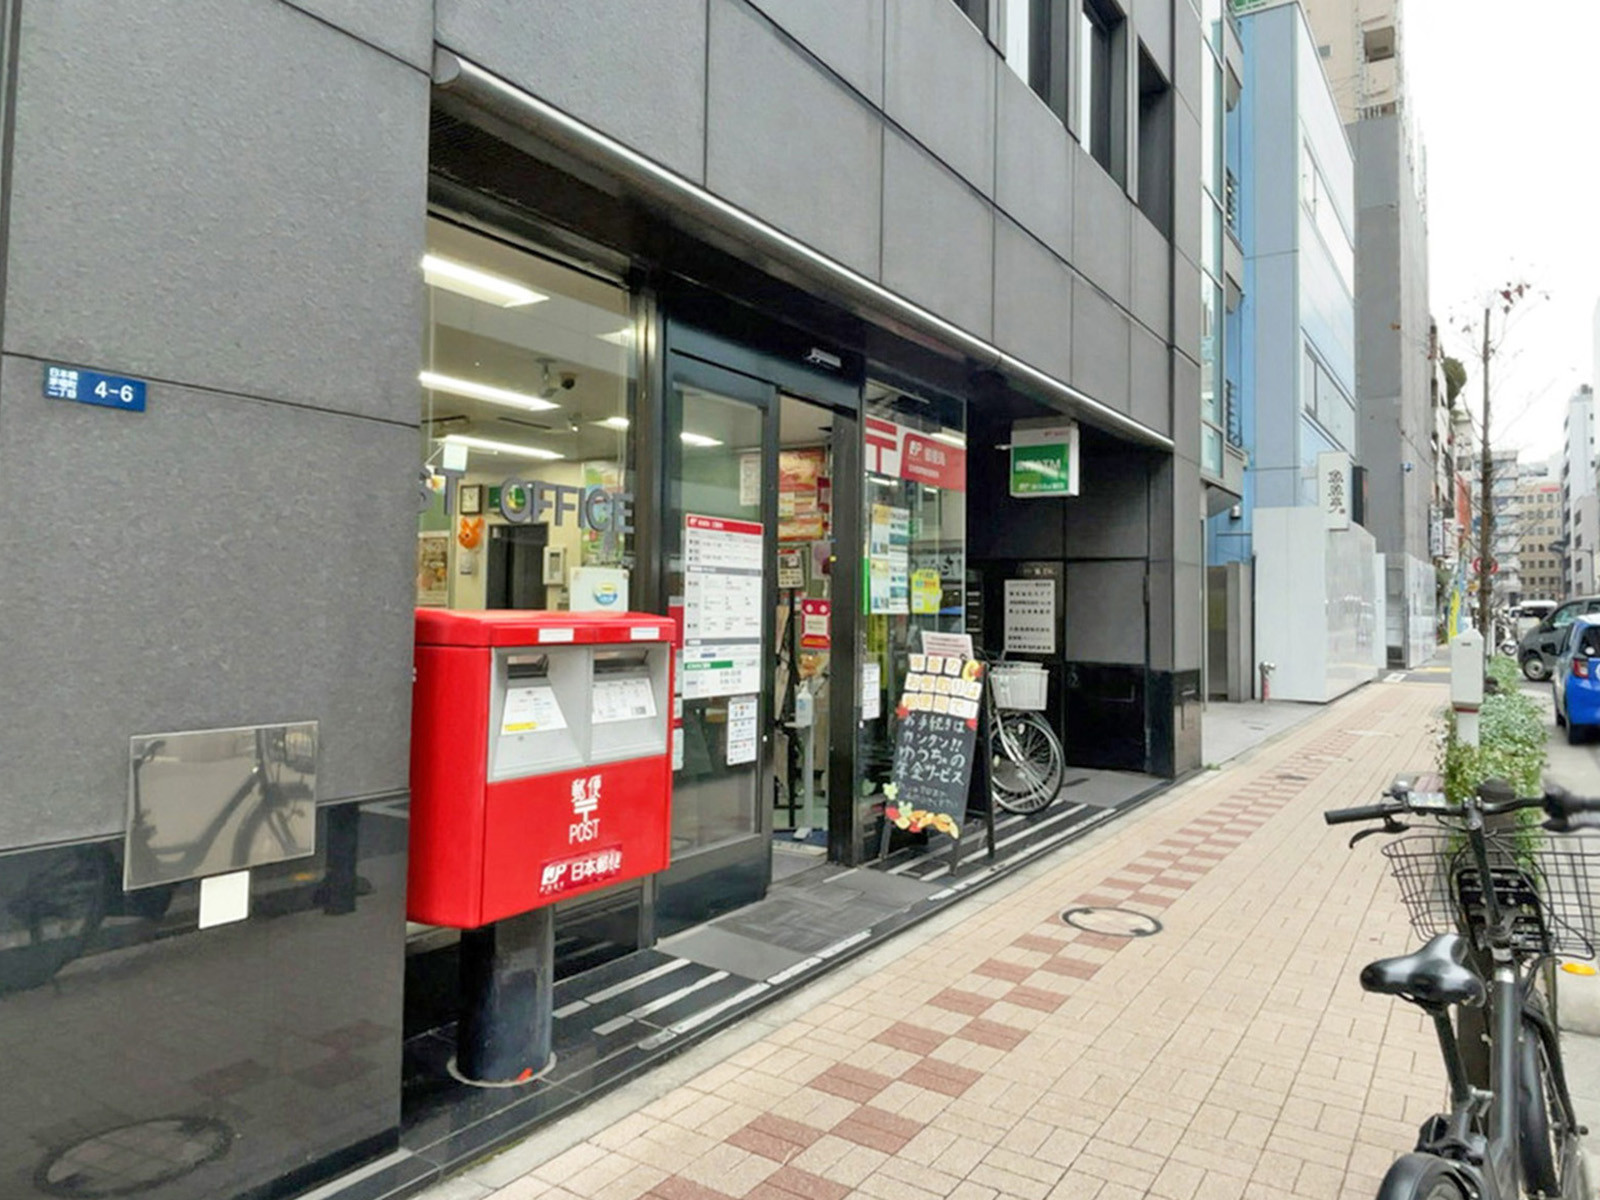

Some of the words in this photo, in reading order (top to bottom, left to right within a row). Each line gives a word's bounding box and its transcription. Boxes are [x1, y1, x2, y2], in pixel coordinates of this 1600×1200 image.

[95, 381, 133, 402] 4-6
[500, 477, 634, 534] OFFICE
[570, 774, 602, 803] 郵便
[568, 818, 601, 845] POST
[571, 850, 622, 882] 日本郵便
